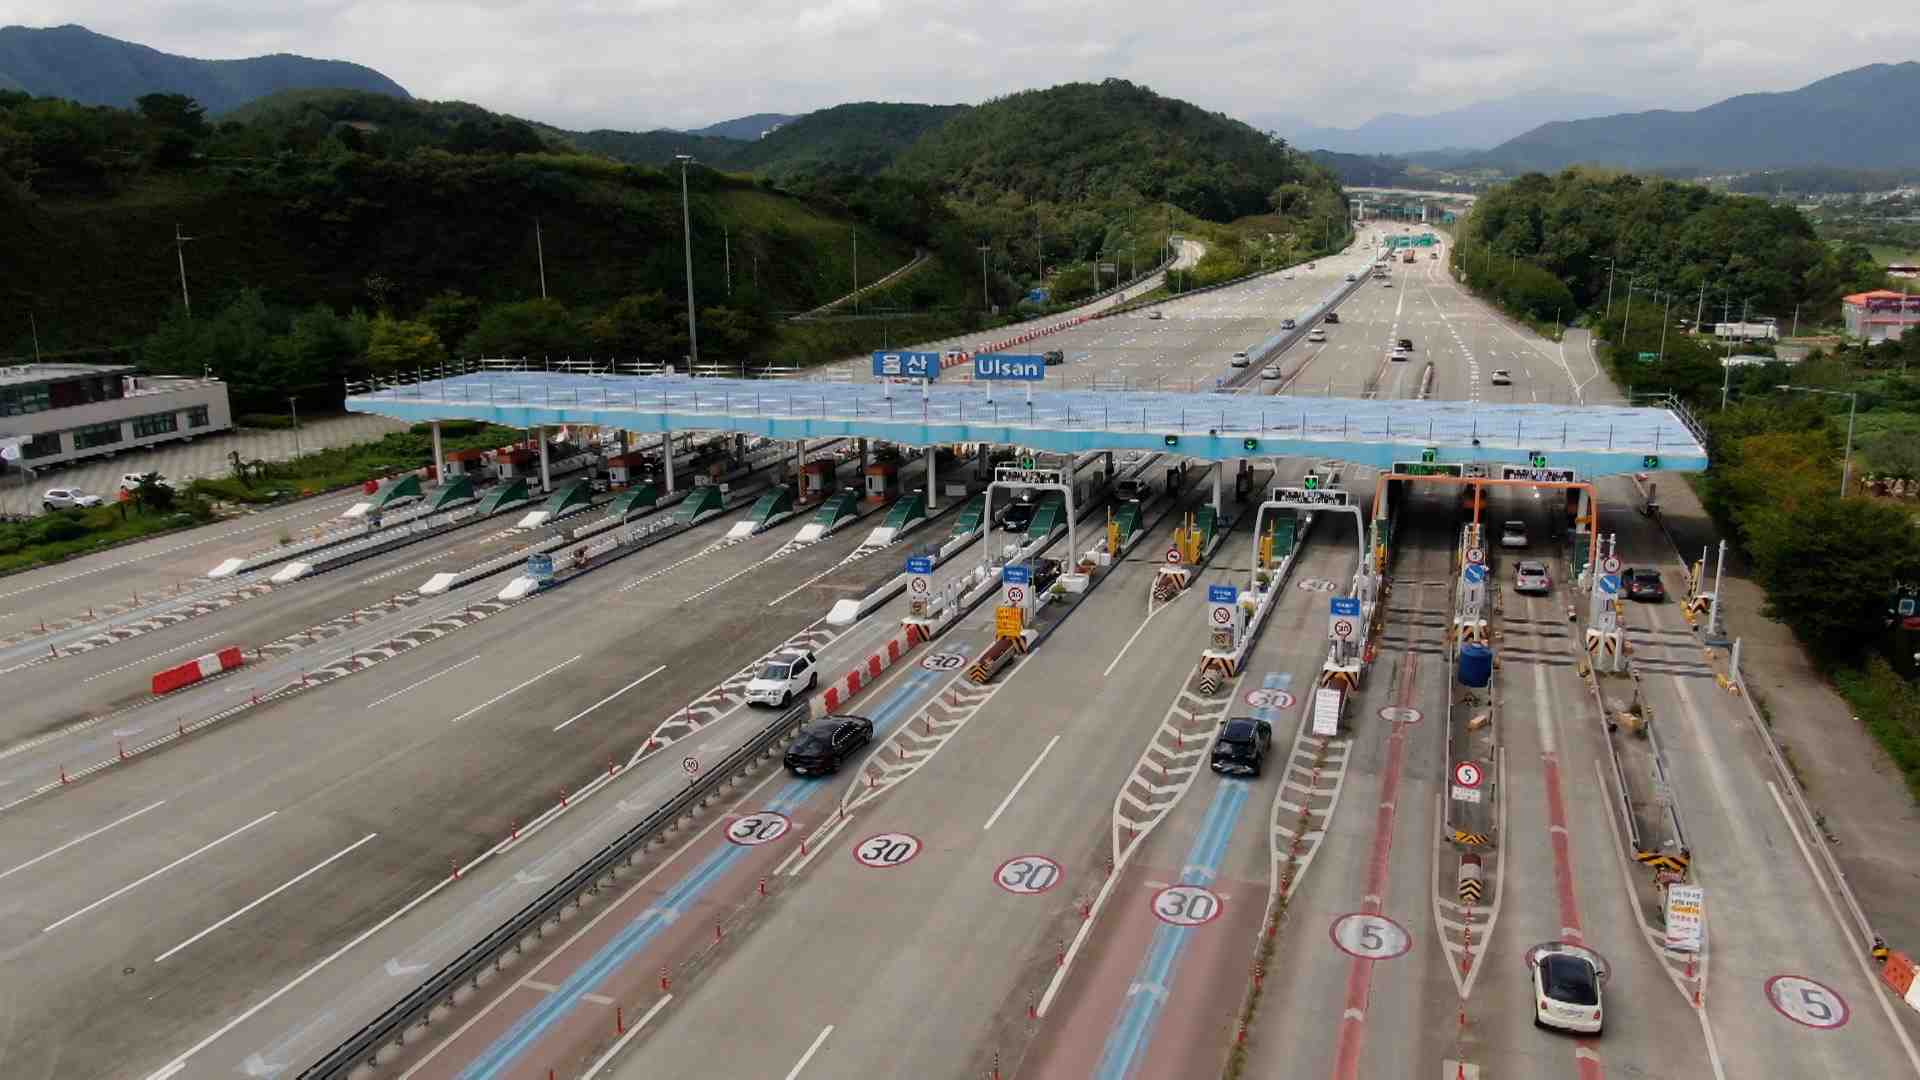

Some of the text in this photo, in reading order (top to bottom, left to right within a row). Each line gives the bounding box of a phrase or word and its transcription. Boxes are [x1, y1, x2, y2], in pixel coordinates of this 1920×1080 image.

[882, 353, 928, 375] 울산
[979, 359, 1038, 376] Ulsan
[926, 655, 960, 669] 30
[1465, 768, 1472, 782] 5
[733, 818, 781, 840] 30
[862, 839, 912, 862] 30
[1003, 862, 1055, 890] 30
[1159, 893, 1212, 920] 30
[1361, 925, 1384, 949] 5
[1800, 988, 1832, 1019] 5
